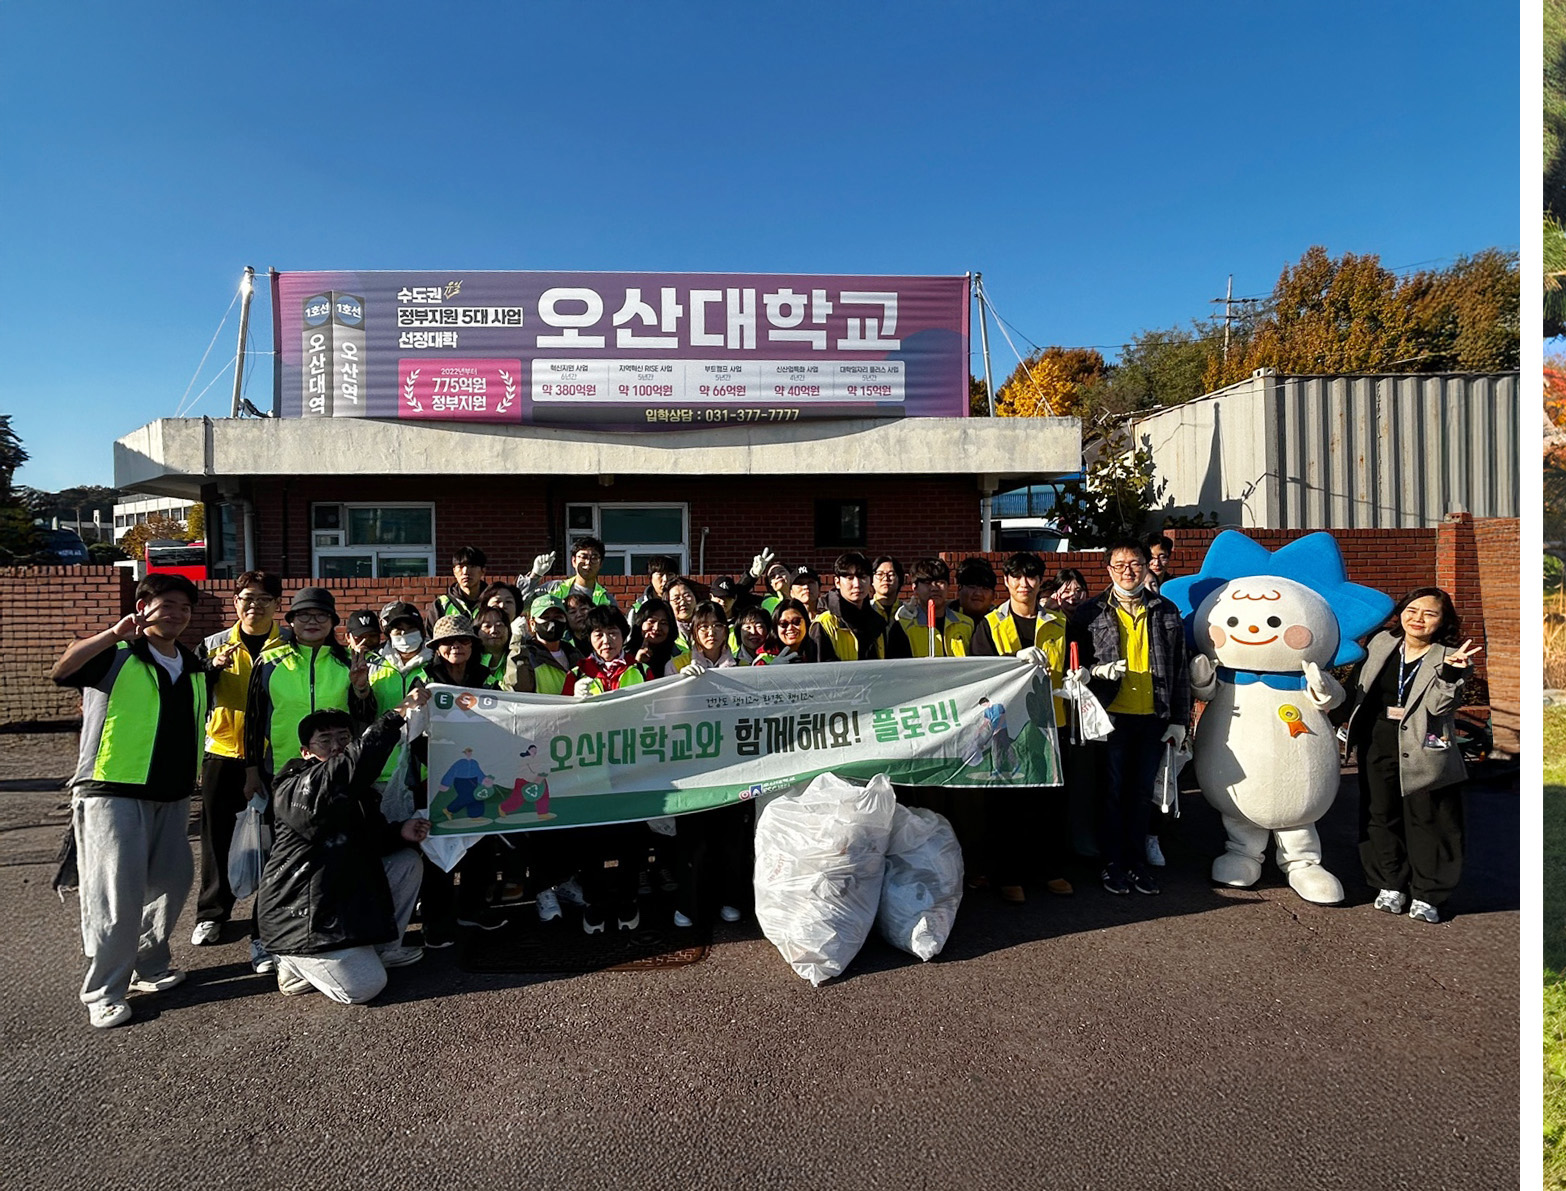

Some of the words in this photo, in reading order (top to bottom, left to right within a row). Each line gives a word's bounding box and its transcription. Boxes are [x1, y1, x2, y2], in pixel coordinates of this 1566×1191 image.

[397, 286, 442, 303] 수도권
[304, 302, 330, 318] 1호선
[336, 303, 362, 319] 1호선
[399, 308, 459, 326] 정부지원
[461, 308, 489, 326] 5대
[491, 308, 522, 326] 사업
[536, 287, 901, 350] 오산대학교
[398, 331, 459, 349] 선정대학
[308, 333, 326, 415] 오산대역
[340, 341, 359, 405] 오산역
[440, 367, 478, 376] 2022년부터
[550, 364, 574, 372] 혁신지원
[575, 364, 589, 372] 사업
[619, 364, 643, 372] 지역혁신
[645, 364, 659, 372] RISE
[660, 364, 673, 372] 사업
[729, 365, 742, 373] 사업
[807, 365, 819, 373] 사업
[431, 377, 487, 393] 775억원
[541, 384, 553, 396] 약
[555, 384, 597, 396] 380억원
[618, 384, 630, 397] 약
[633, 384, 673, 397] 100억원
[699, 385, 711, 397] 약
[713, 385, 747, 397] 66억원
[774, 385, 785, 397] 약
[787, 385, 820, 397] 40억원
[847, 385, 858, 397] 약
[861, 385, 892, 397] 15억원
[431, 395, 487, 411] 정부지원
[645, 409, 693, 422] 입학상담
[705, 409, 800, 422] 031-377-7777
[549, 720, 724, 773] 오산대학교와
[734, 710, 862, 756] 함께해요!
[871, 698, 962, 744] 플로깅!
